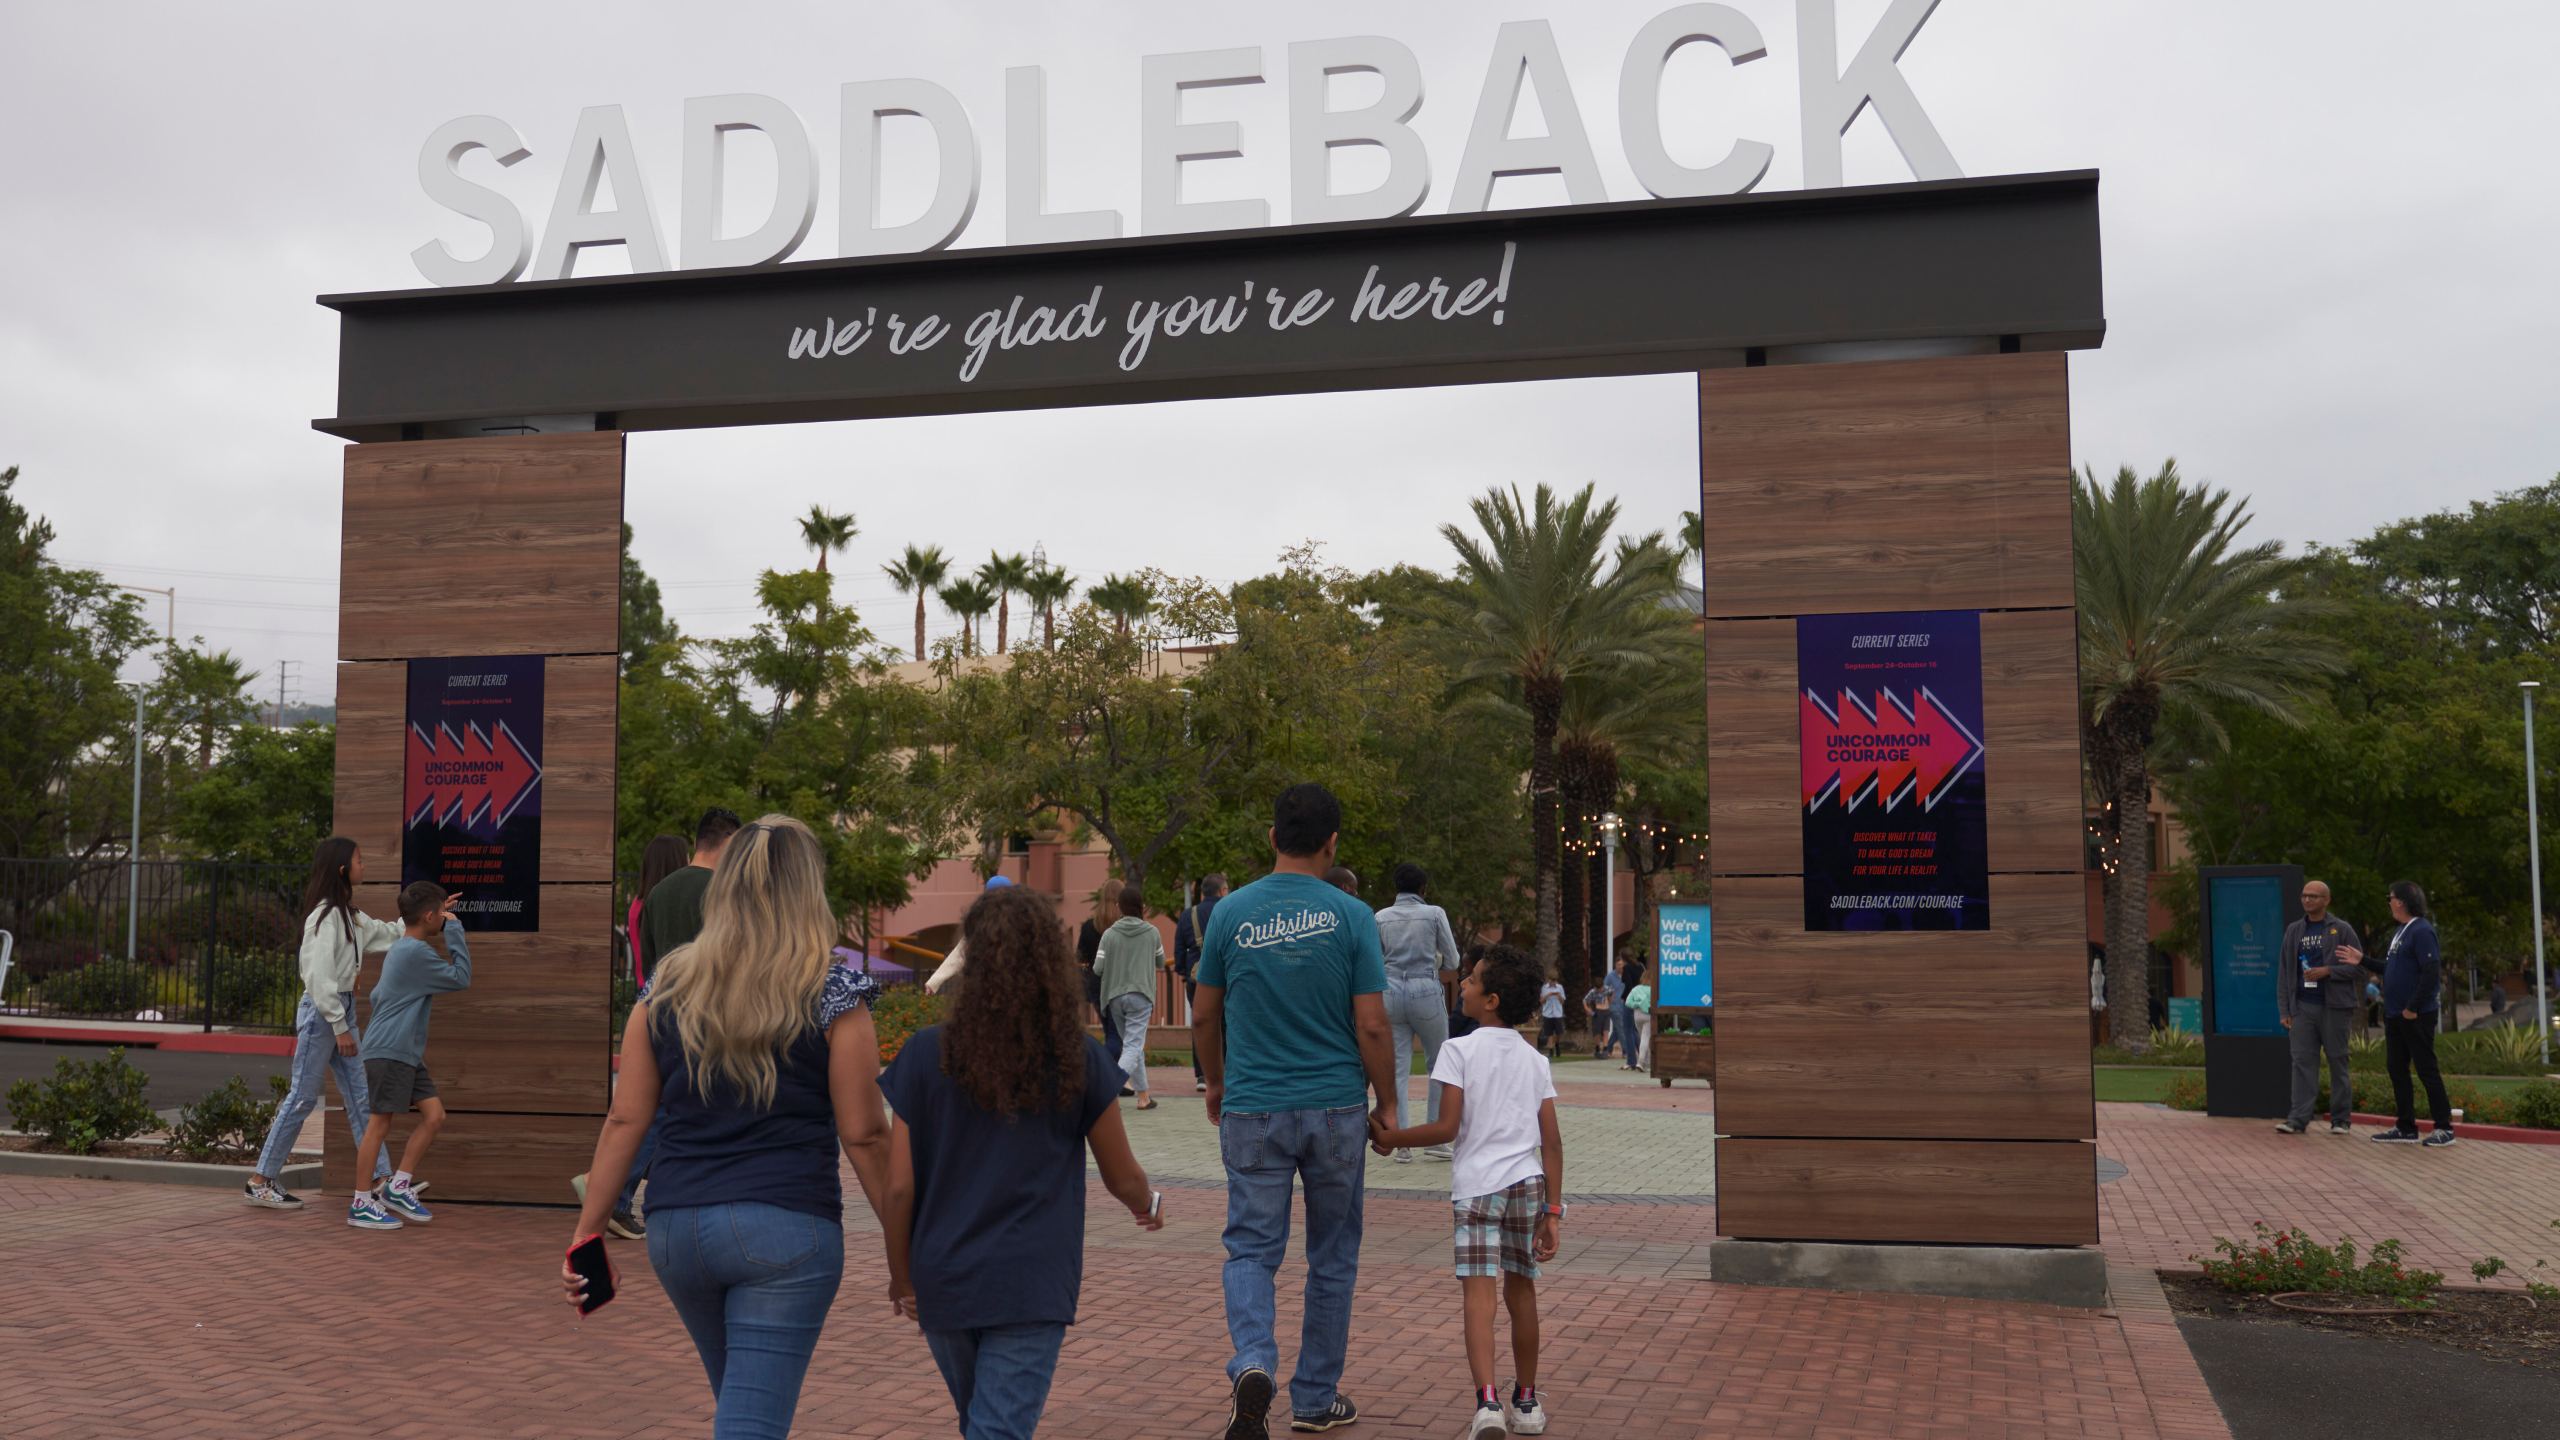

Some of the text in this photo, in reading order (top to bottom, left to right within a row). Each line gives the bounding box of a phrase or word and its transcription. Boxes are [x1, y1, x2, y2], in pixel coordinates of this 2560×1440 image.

[410, 0, 1965, 289] SADDLEBACK
[788, 241, 1516, 382] we're glad you're here!
[1851, 634, 1930, 648] CURRENT SERIES
[1844, 662, 1884, 671] September
[448, 674, 508, 687] CURRENT SERIES
[1826, 734, 1931, 748] UNCOMMON
[1827, 749, 1910, 762] COURAGE
[425, 761, 504, 773] UNCOMMON
[425, 774, 487, 786] COURAGE
[1853, 832, 1937, 842] DISCOVER WHAT IT TAKES
[1858, 849, 1934, 858] TO MAKE GOD'S DREAM
[1852, 865, 1867, 875] FOR
[1868, 865, 1887, 875] YOUR
[1888, 865, 1903, 875] LIFE
[1903, 865, 1910, 875] A
[448, 900, 523, 913] ACK.COM/COURAGE
[1830, 895, 1964, 909] SADDLEBACK.COM/COURAGE
[1235, 909, 1339, 948] Quiksilver
[1661, 919, 1699, 931] We're
[1661, 933, 1690, 946] Glad
[1661, 948, 1702, 961] You're
[1661, 963, 1696, 976] Here!
